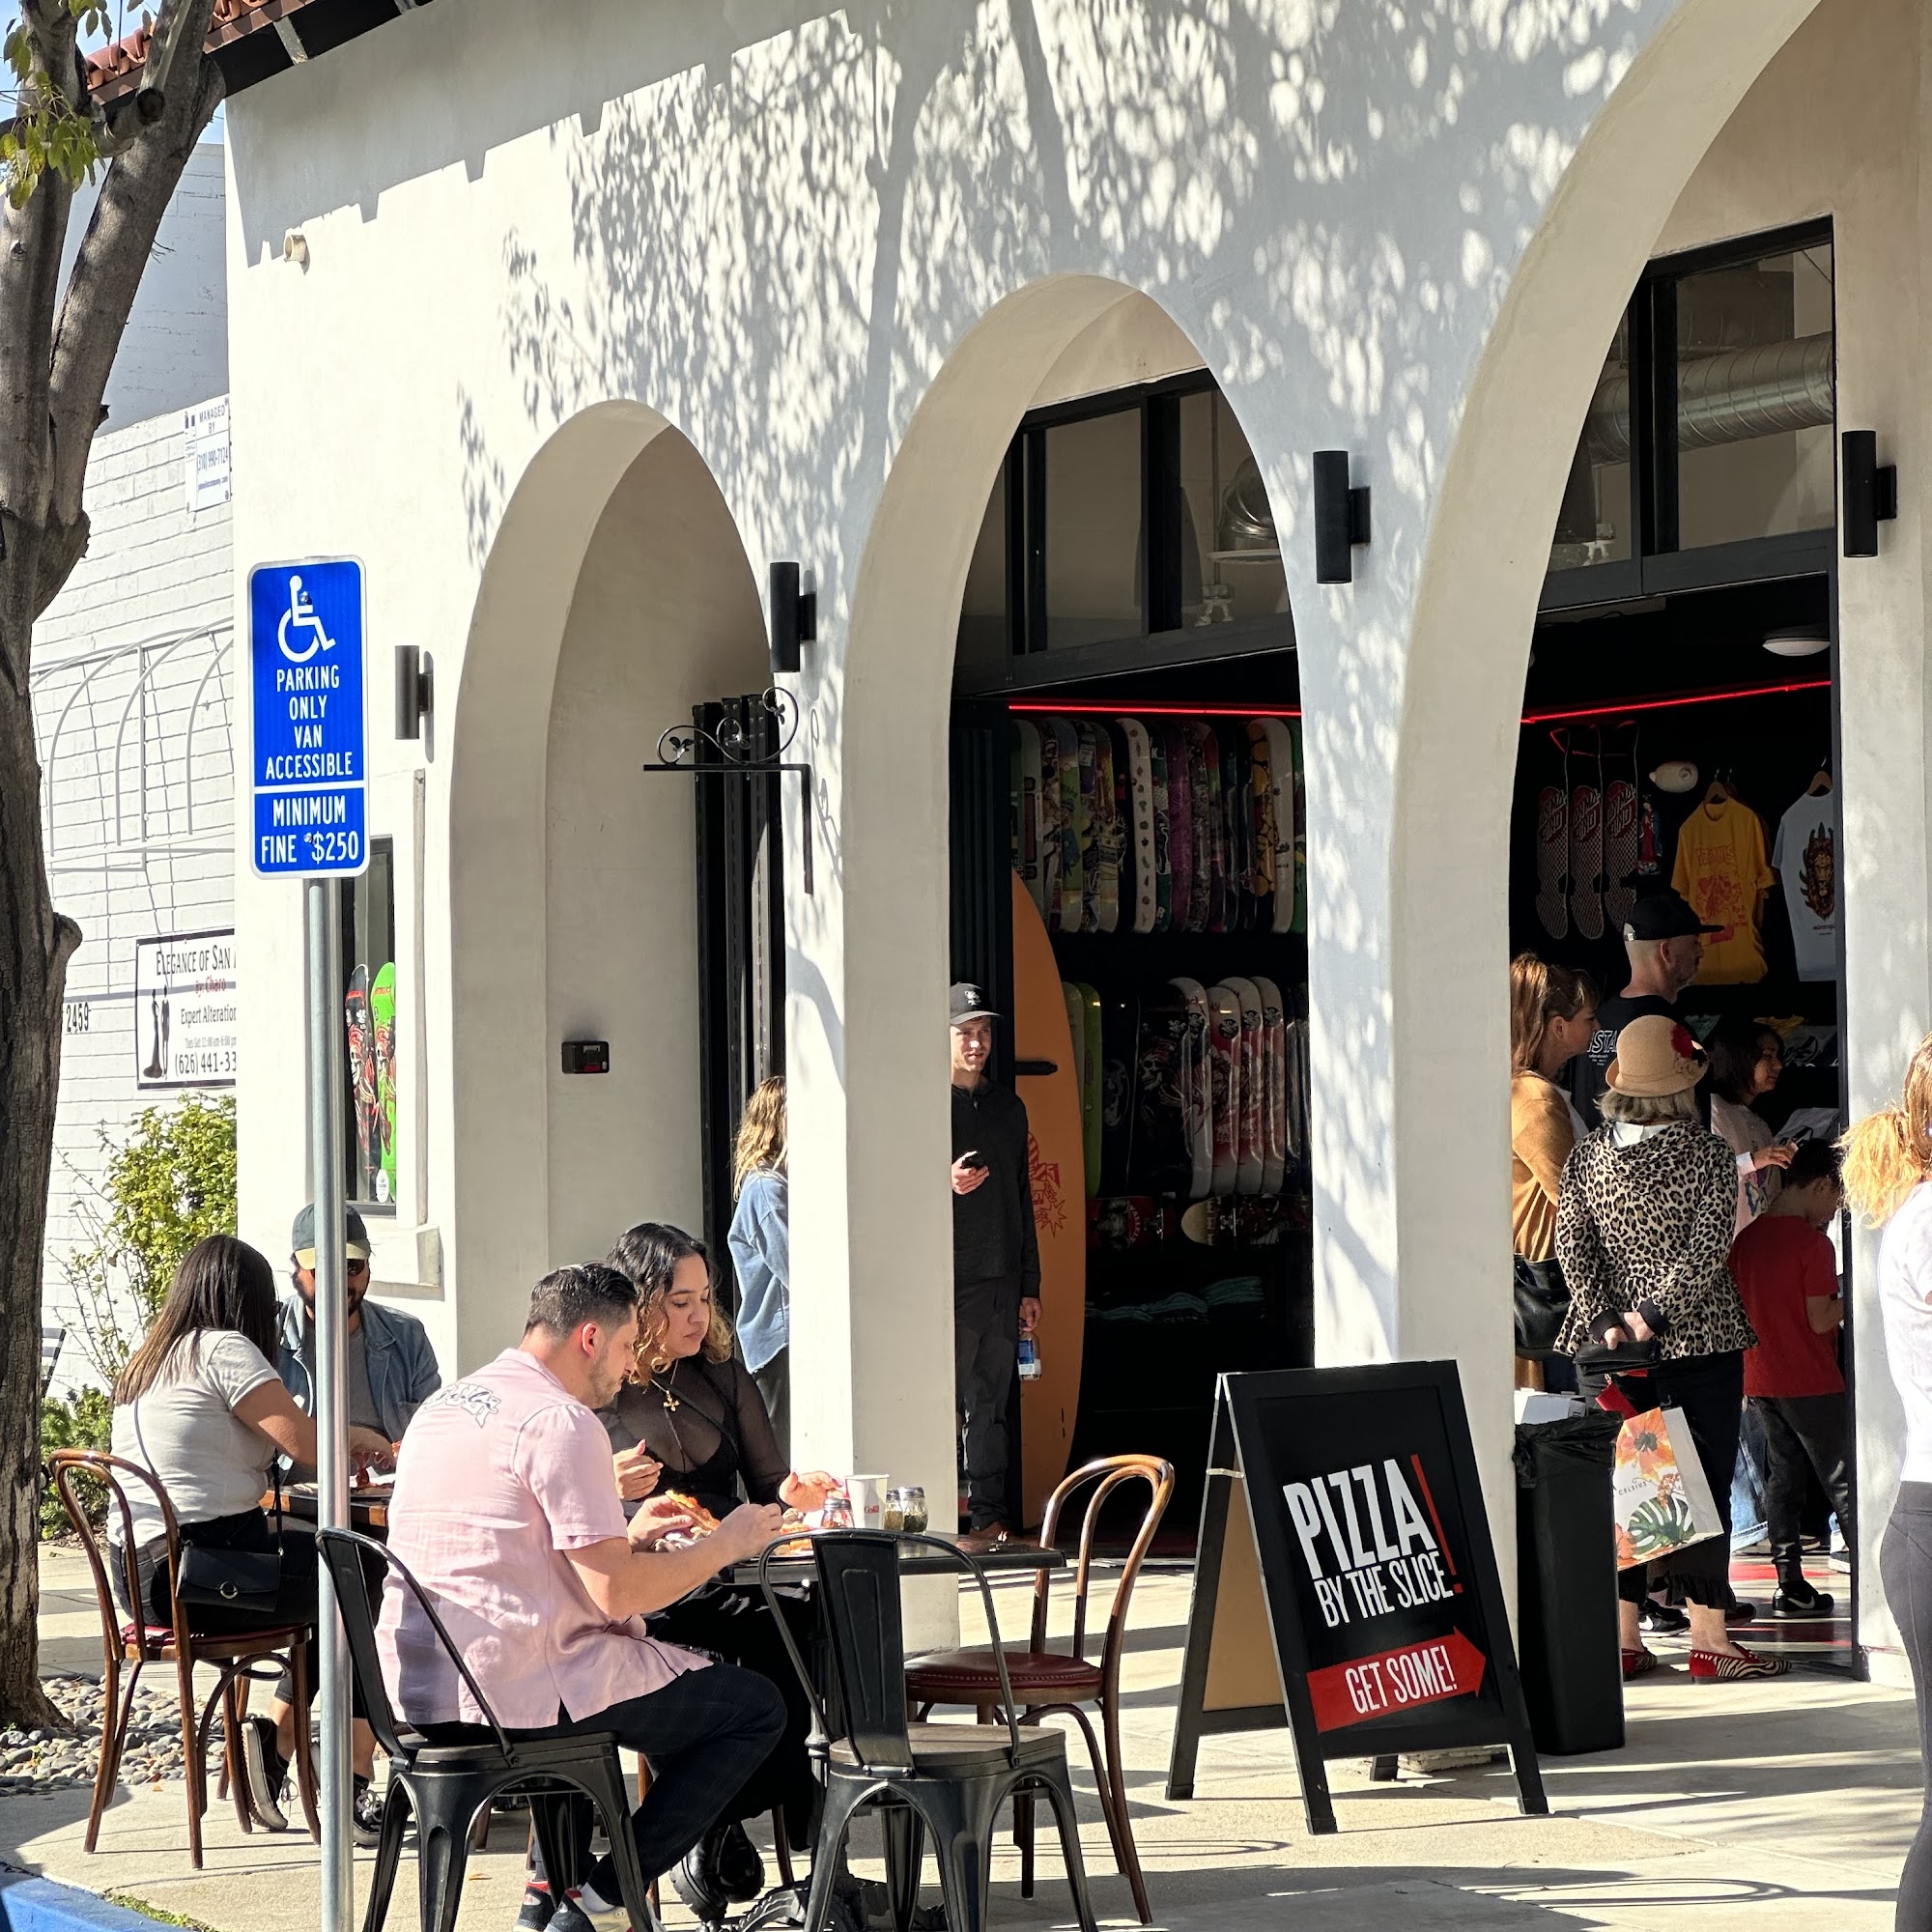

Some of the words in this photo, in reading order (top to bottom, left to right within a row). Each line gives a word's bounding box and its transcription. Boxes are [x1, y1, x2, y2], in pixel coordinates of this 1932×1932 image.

[199, 404, 225, 423] MANAGED
[208, 422, 215, 434] BY
[276, 665, 340, 693] PARKING
[289, 695, 327, 721] ONLY
[294, 724, 323, 749] VAN
[265, 752, 354, 781] ACCESSIBLE
[272, 795, 346, 827] MINIMUM
[261, 834, 297, 865] FINE
[311, 830, 359, 865] $250
[66, 1001, 90, 1033] 2459
[181, 1007, 202, 1029] Expert
[175, 1052, 199, 1077] (626)
[1618, 1481, 1647, 1495] CELSIUS
[1313, 1575, 1350, 1628] BY
[1344, 1563, 1396, 1618] THE
[1344, 1661, 1388, 1715] GET
[1385, 1644, 1459, 1704] SOME!
